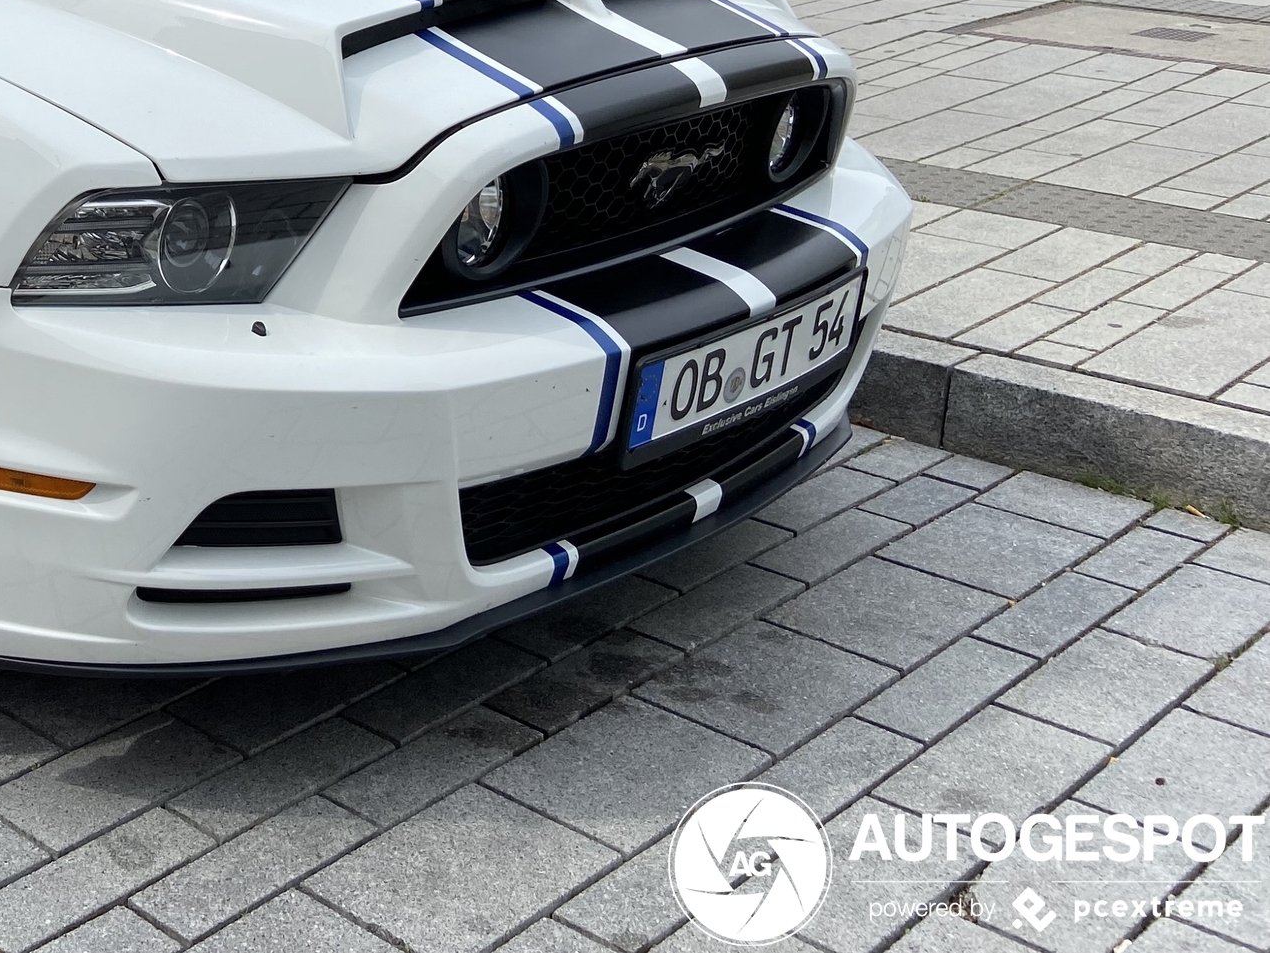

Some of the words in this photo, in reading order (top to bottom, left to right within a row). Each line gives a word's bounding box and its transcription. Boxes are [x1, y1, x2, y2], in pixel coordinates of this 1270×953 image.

[670, 348, 726, 421] OB
[749, 314, 803, 389] GT
[808, 289, 850, 361] 54
[637, 413, 648, 432] D
[701, 411, 743, 435] Exclusive
[744, 402, 763, 417] Cars
